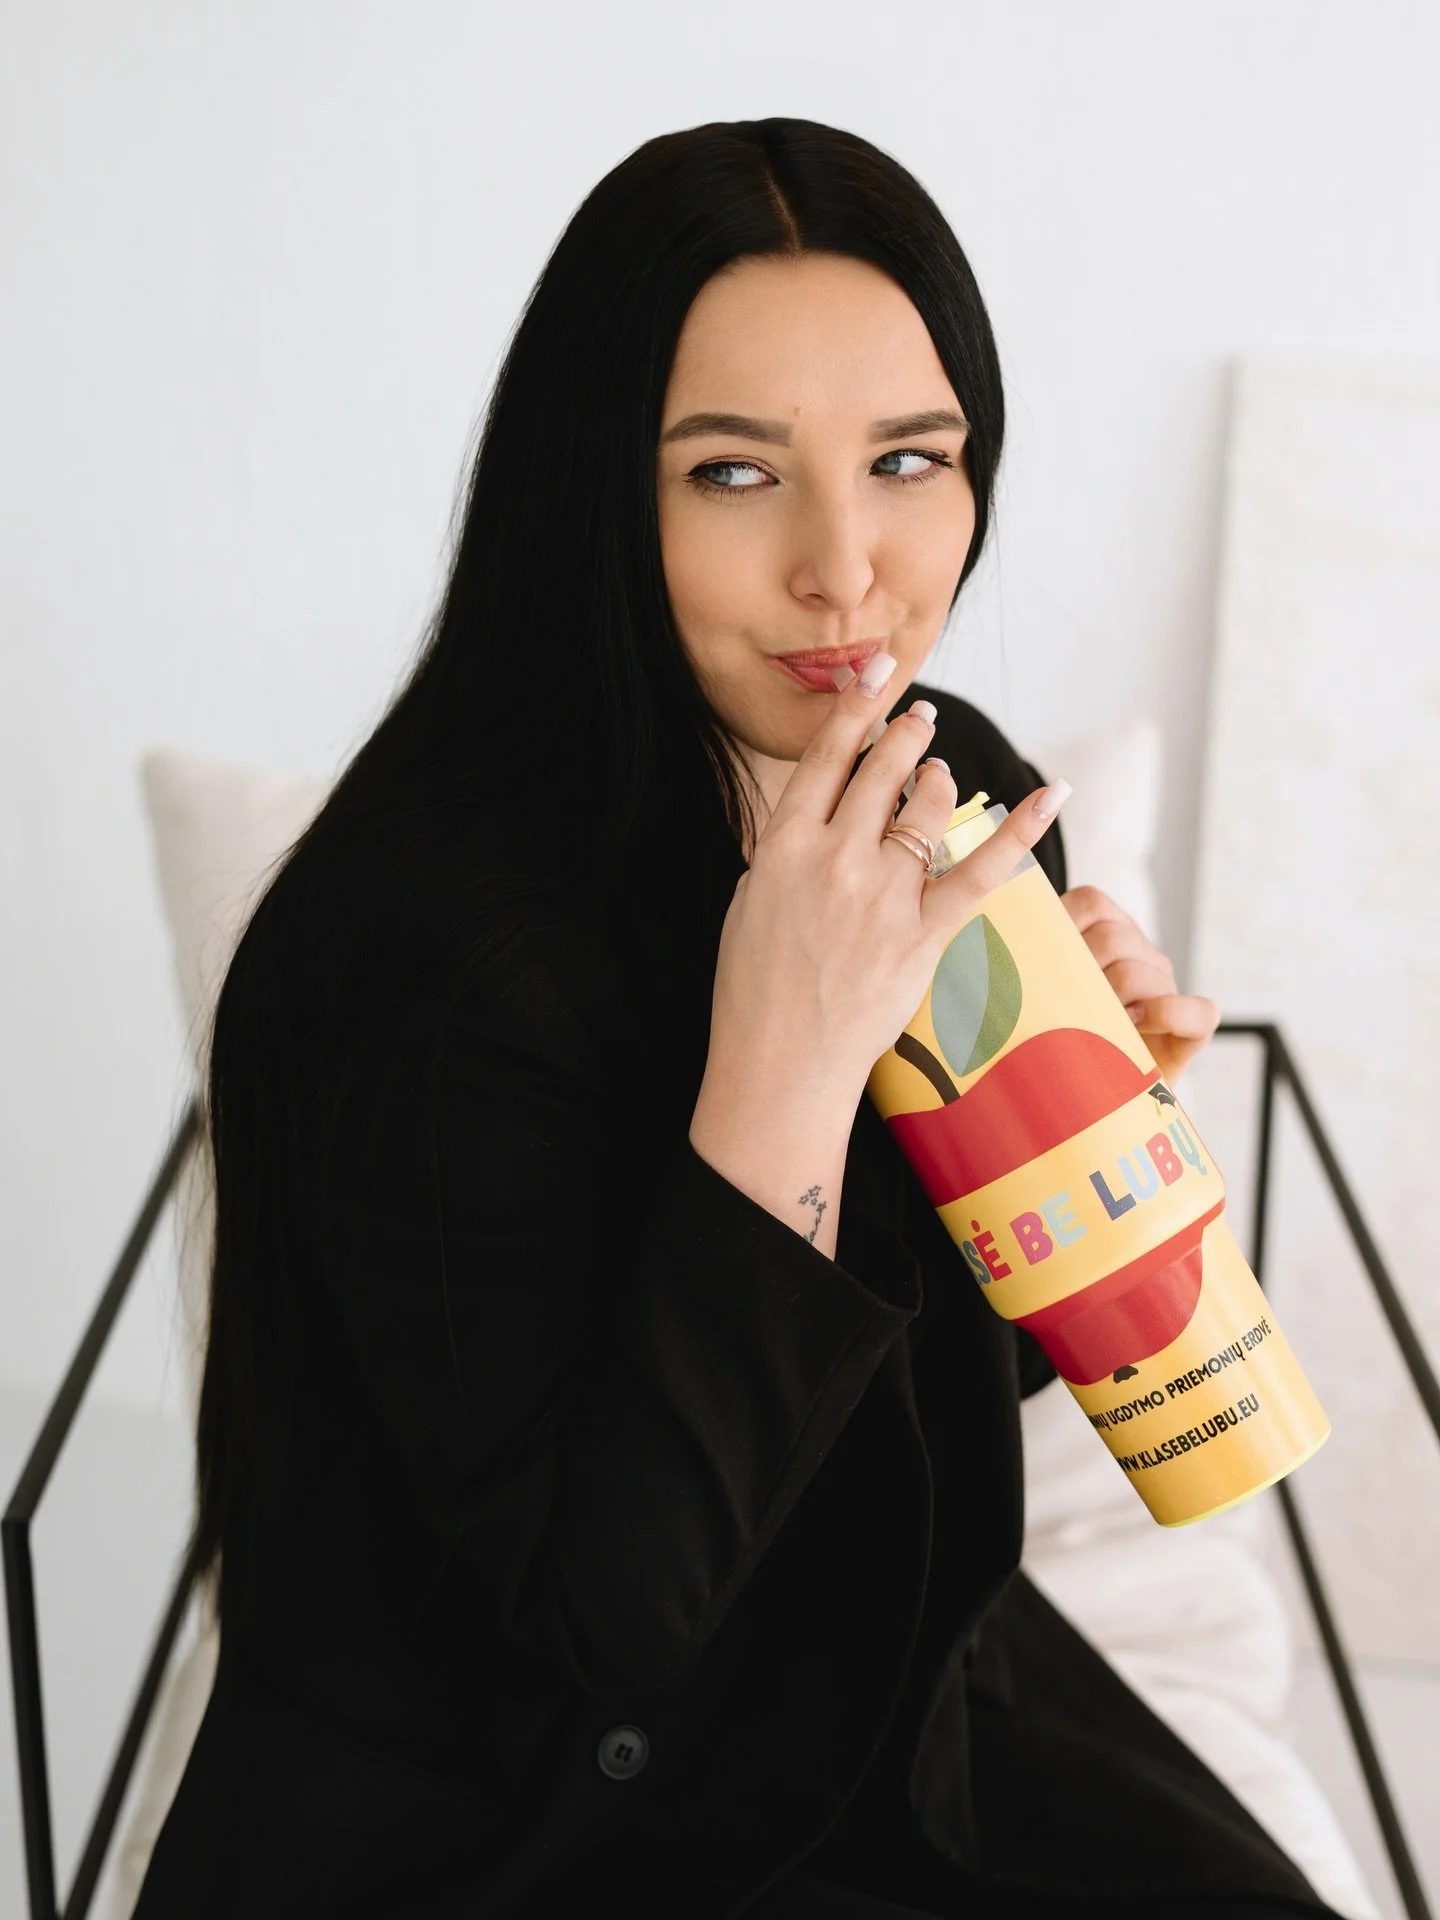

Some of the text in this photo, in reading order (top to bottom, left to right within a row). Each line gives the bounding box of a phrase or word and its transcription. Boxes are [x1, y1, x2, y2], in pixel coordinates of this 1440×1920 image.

[1009, 1191, 1088, 1265] BE
[1089, 1117, 1208, 1221] LUBŲ
[1106, 1390, 1165, 1425] UGDYMO
[1165, 1341, 1246, 1399] PRIEMONIŲ
[1241, 1315, 1272, 1351] ERDVĖ
